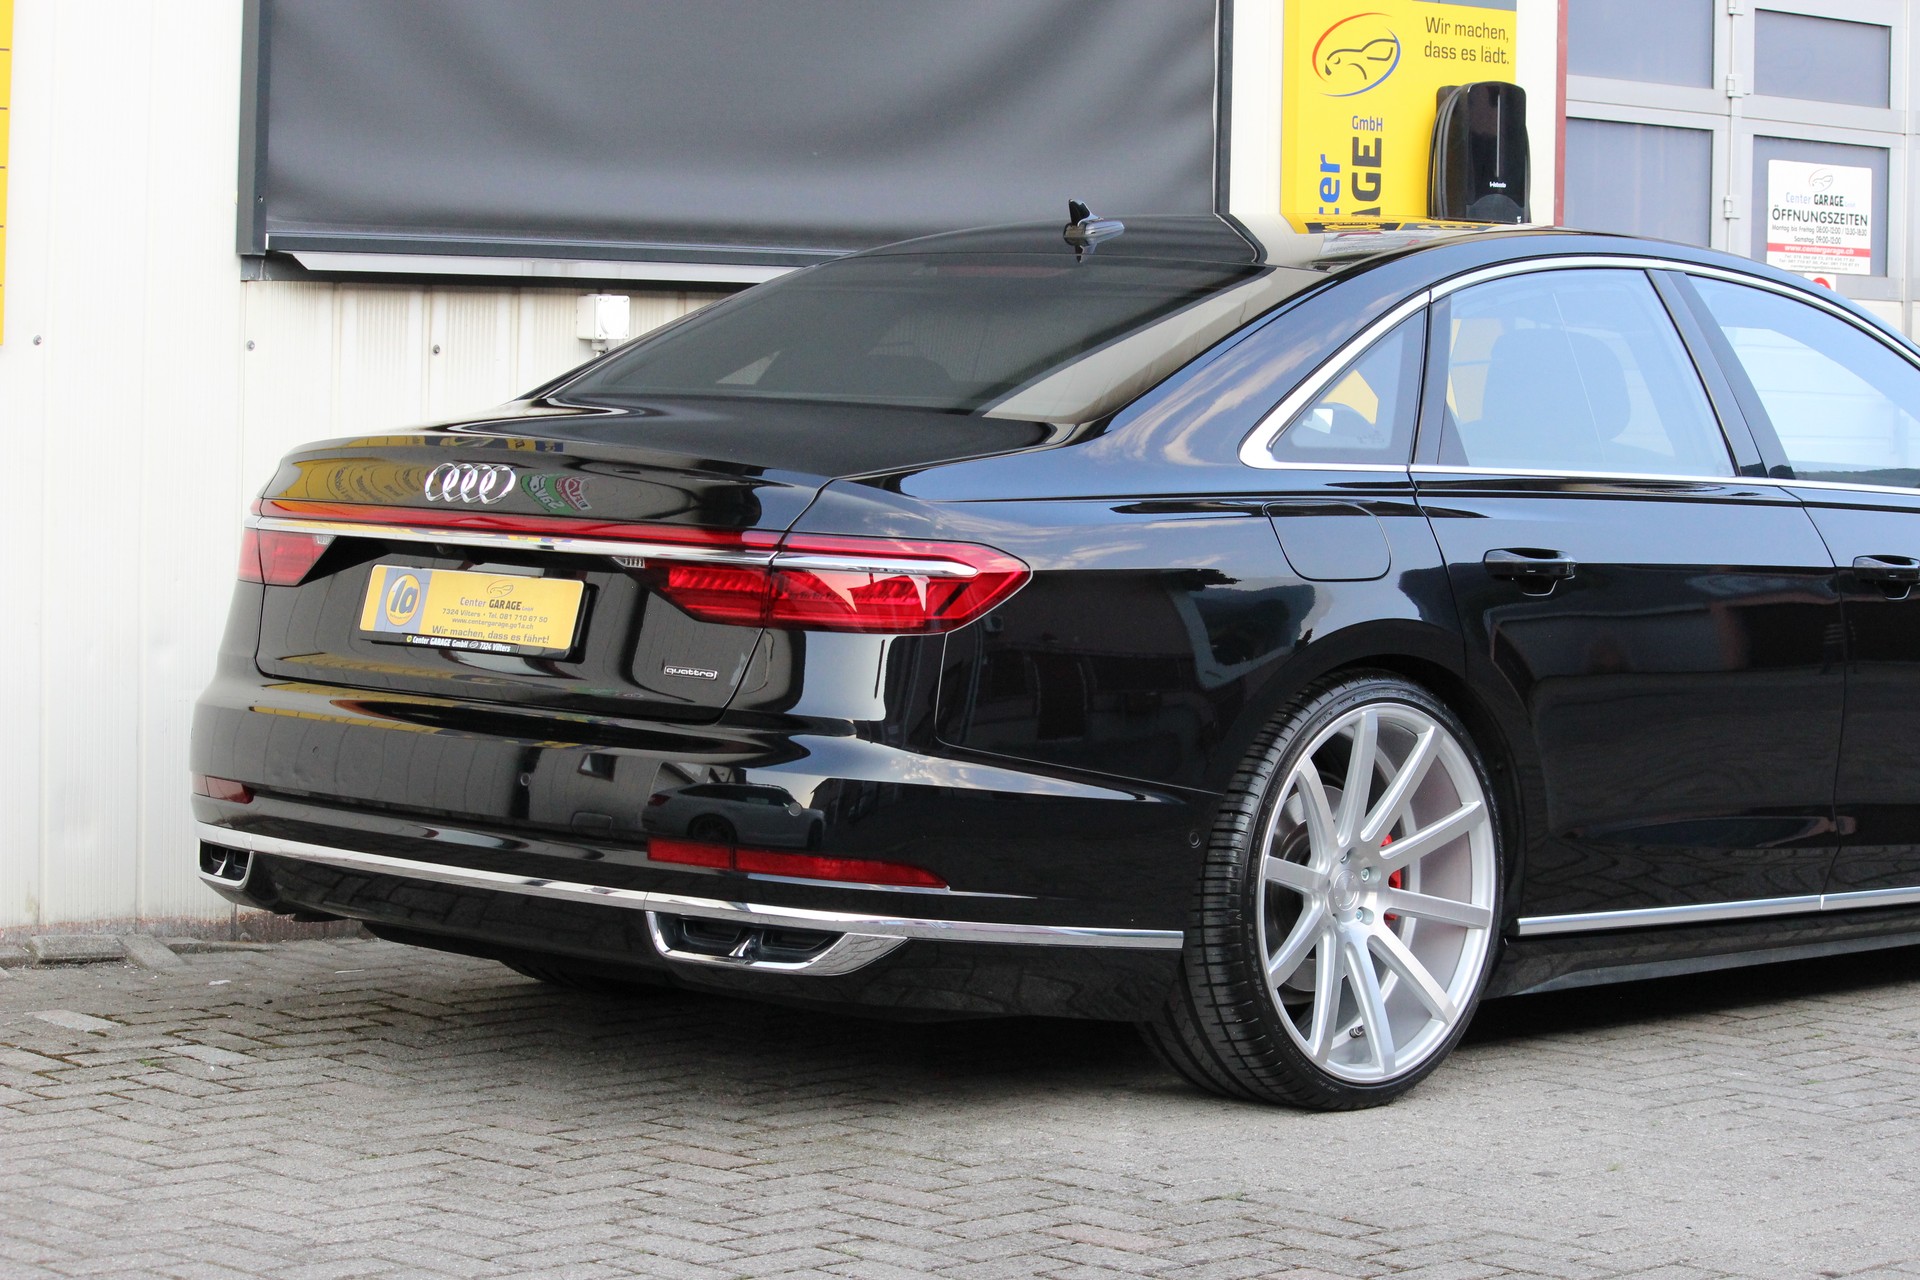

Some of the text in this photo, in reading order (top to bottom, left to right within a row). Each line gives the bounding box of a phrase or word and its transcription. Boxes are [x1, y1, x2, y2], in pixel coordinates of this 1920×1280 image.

[1425, 16, 1509, 43] Wir machen,
[1424, 40, 1510, 65] dass es lädt.
[1352, 116, 1383, 132] GmbH
[1786, 192, 1811, 204] Center
[1814, 194, 1844, 207] GARAGE
[1772, 204, 1868, 226] ÖFFNUNGSZEITEN
[460, 597, 486, 607] Center
[489, 599, 522, 611] GARAGE
[460, 609, 480, 617] Vilters
[432, 626, 550, 644] Wir machen, dass es fährt!
[412, 636, 511, 652] Center GARAGE GmbH 7324 Vilters
[666, 667, 714, 678] quattro
